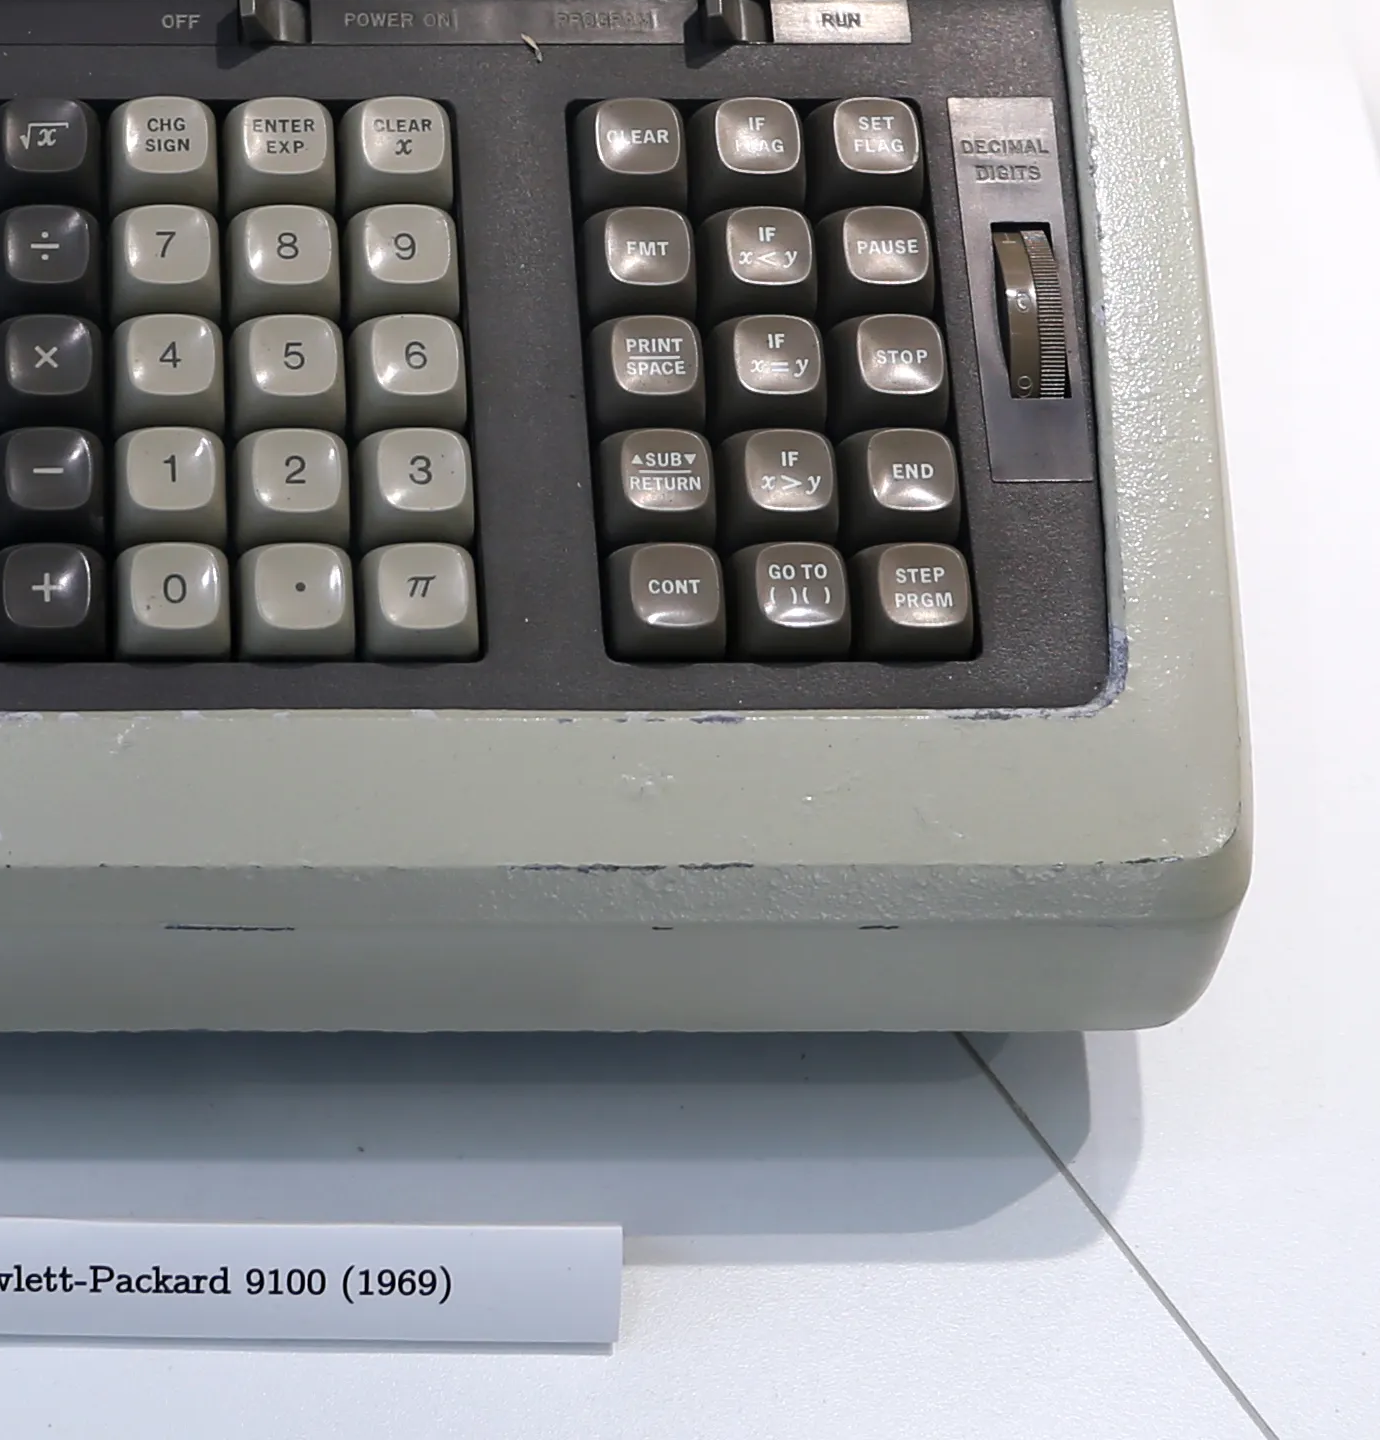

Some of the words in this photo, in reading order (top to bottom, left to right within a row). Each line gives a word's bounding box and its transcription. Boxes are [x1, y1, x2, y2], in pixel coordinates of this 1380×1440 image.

[162, 14, 201, 29] OFF
[344, 12, 414, 28] POWER
[424, 12, 450, 27] ON
[821, 12, 862, 28] RUN
[147, 118, 186, 132] CHG
[252, 119, 315, 133] ENTER
[374, 118, 432, 133] CLEAR
[748, 117, 765, 131] IF
[858, 116, 894, 131] SET
[607, 129, 669, 145] CLEAR
[145, 138, 190, 153] SIGN
[266, 140, 304, 154] EXP
[394, 139, 413, 155] x
[735, 139, 784, 153] FLAG
[854, 138, 904, 154] FLAG
[960, 139, 1049, 154] DECIMAL
[975, 165, 1041, 181] DIGITS
[759, 227, 776, 242] IF
[155, 231, 176, 258] 7
[276, 232, 299, 260] 8
[393, 233, 417, 261] 9
[626, 241, 669, 256] FMT
[857, 239, 919, 254] PAUSE
[625, 338, 683, 353] PRINT
[767, 333, 785, 349] IF
[159, 341, 182, 370] 4
[283, 341, 306, 370] 5
[404, 340, 428, 370] 6
[876, 349, 928, 364] STOP
[626, 360, 686, 376] SPACE
[645, 453, 682, 467] SUB
[780, 451, 799, 466] IF
[163, 454, 177, 482] 1
[284, 456, 307, 484] 2
[408, 456, 432, 485] 3
[892, 464, 934, 479] END
[629, 476, 702, 491] RETURN
[769, 564, 796, 580] GO
[801, 564, 827, 579] TO
[895, 567, 945, 583] STEP
[162, 574, 187, 603] 0
[647, 579, 700, 595] CONT
[895, 592, 953, 608] PRGM
[245, 1268, 326, 1295] 9100
[342, 1265, 452, 1305] (1969)
